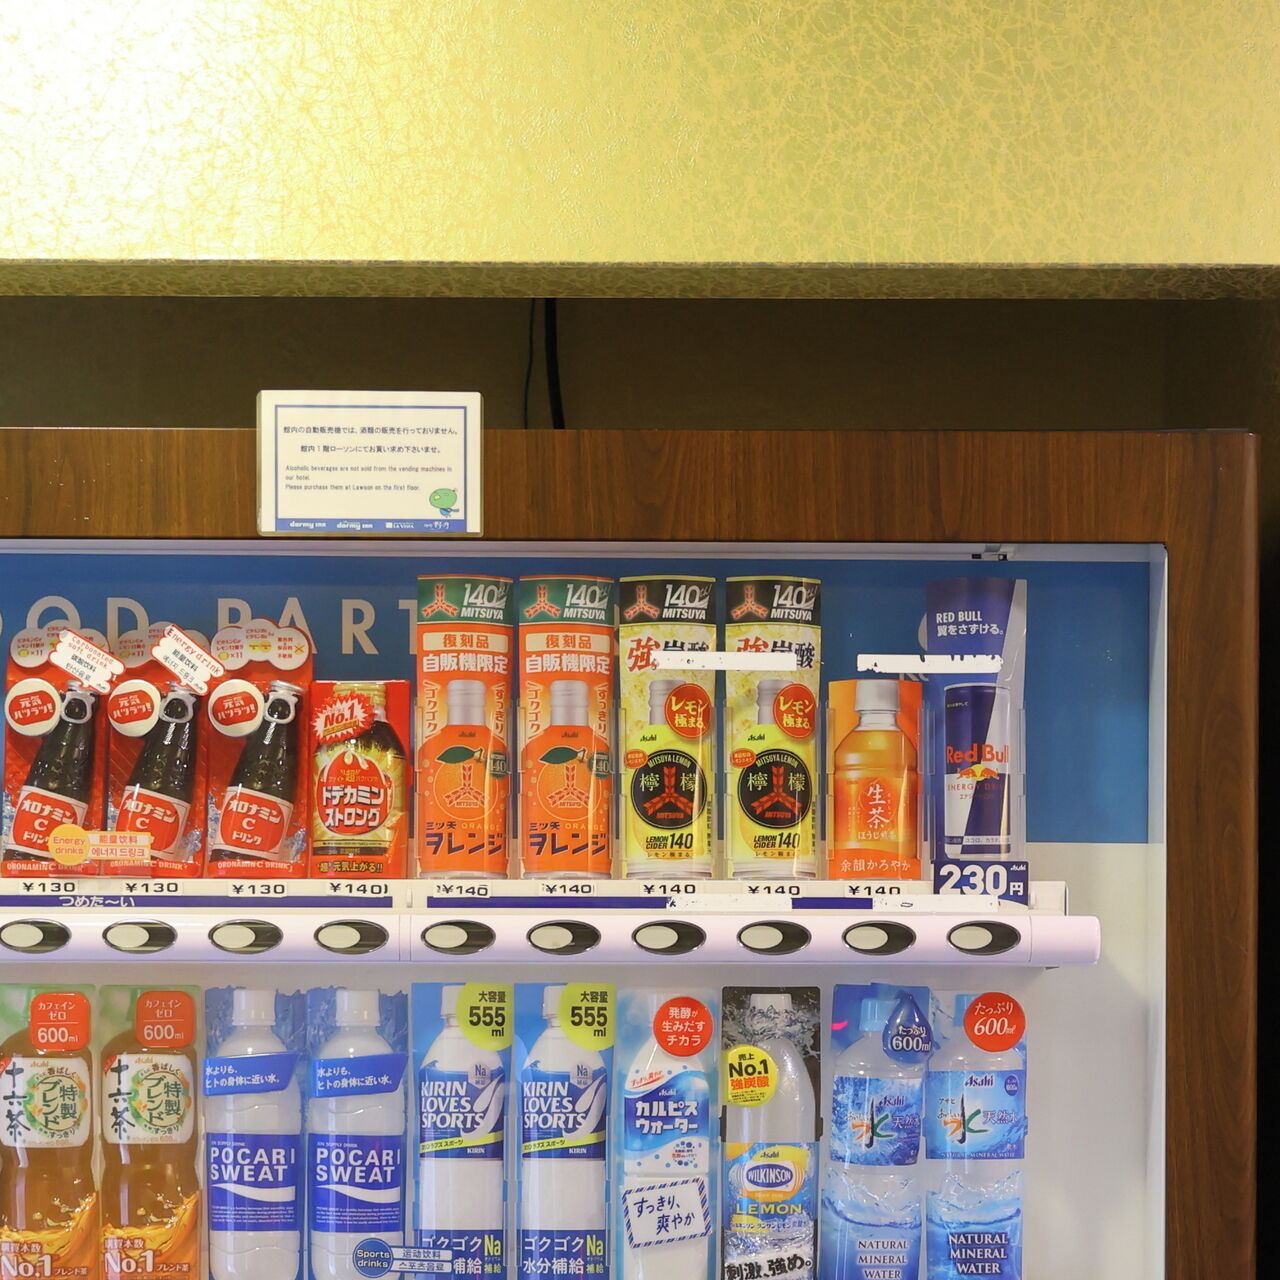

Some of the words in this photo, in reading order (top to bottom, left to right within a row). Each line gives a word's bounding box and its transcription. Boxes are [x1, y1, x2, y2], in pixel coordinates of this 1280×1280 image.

[461, 607, 503, 620] MITSUYA
[563, 607, 606, 621] MITSUYA
[662, 608, 706, 620] MITSUYA
[936, 612, 955, 624] RED
[958, 611, 982, 622] BULL
[444, 634, 489, 648] 復刻品
[423, 653, 508, 674] 自販機限定
[526, 654, 610, 675] 自販機限定
[671, 697, 709, 714] レモン
[946, 744, 978, 763] Red
[982, 744, 1009, 763] Bull
[321, 786, 384, 807] ドデカミン
[324, 807, 381, 828] ストロング
[53, 836, 86, 847] Energy
[22, 882, 76, 893] ¥130
[125, 882, 178, 893] ¥130
[644, 884, 696, 894] ¥140
[748, 885, 800, 895] ¥140
[479, 991, 506, 1003] 大容量
[581, 991, 607, 1003] 大容量
[39, 1002, 75, 1010] カフェイン
[48, 1011, 66, 1021] ゼロ
[469, 1006, 505, 1027] 555
[571, 1006, 607, 1027] 555
[662, 1021, 705, 1032] 生みだす
[666, 1035, 701, 1046] チカラ
[729, 1059, 769, 1078] No.1
[730, 1076, 769, 1090] 強炭酸
[965, 1075, 994, 1087] Asahi
[421, 1081, 467, 1096] KIRIN
[523, 1081, 568, 1096] KIRIN
[422, 1098, 471, 1112] LOVES
[524, 1098, 572, 1112] LOVES
[636, 1101, 698, 1117] カルピス
[422, 1113, 485, 1128] SPORTS
[524, 1113, 587, 1128] SPORTS
[211, 1148, 295, 1165] POCARI
[316, 1148, 400, 1166] POCARI
[211, 1165, 288, 1182] SWEAT
[316, 1165, 395, 1183] SWEAT
[748, 1168, 791, 1183] WILKINSON
[736, 1204, 801, 1215] LEMON
[858, 1240, 908, 1249] NATURAL
[949, 1234, 1008, 1244] NATURAL
[357, 1249, 390, 1260] Sports
[402, 1249, 441, 1259] 运动饮料
[858, 1255, 907, 1264] MINERAL
[950, 1249, 1007, 1259] MINERAL
[358, 1259, 388, 1268] drinks
[399, 1261, 445, 1272] 스포츠음료
[523, 1258, 584, 1275] 水分補給
[957, 1262, 1001, 1274] WATER
[864, 1269, 901, 1279] WATER
